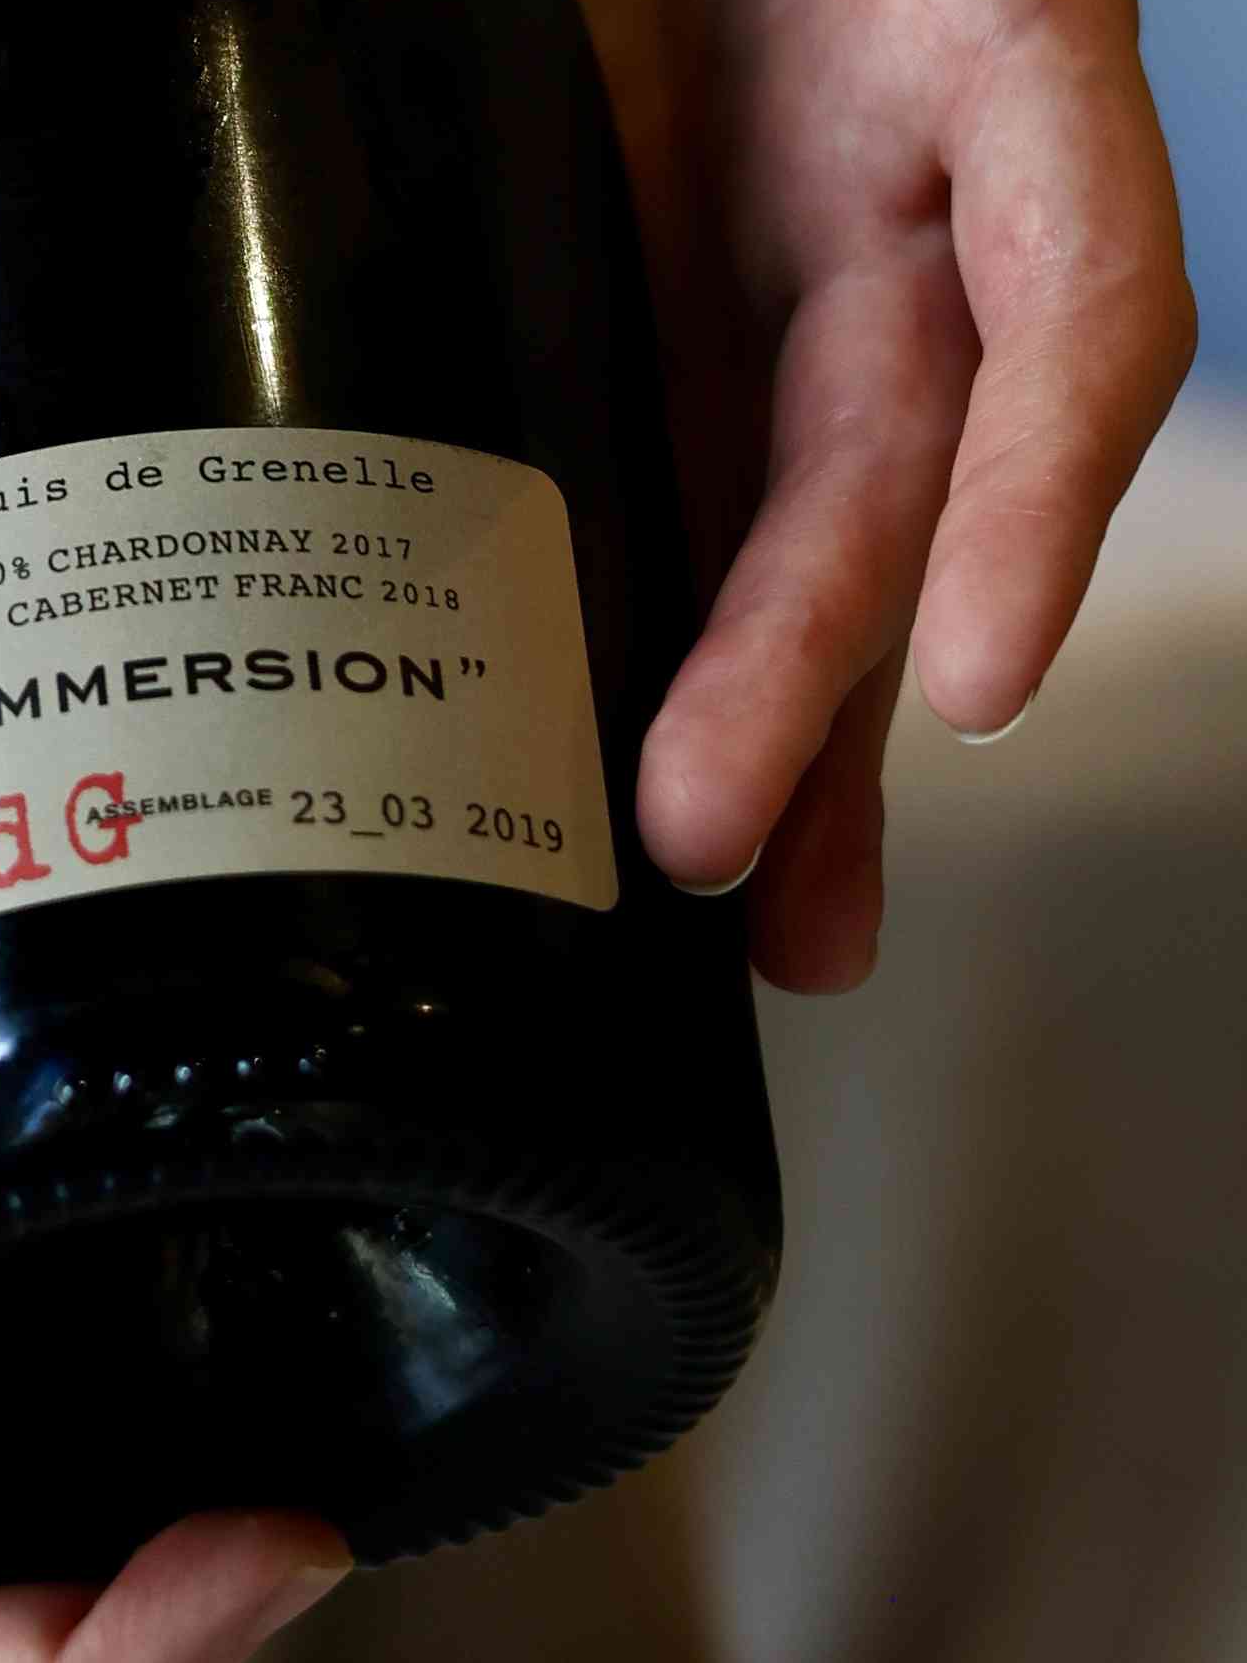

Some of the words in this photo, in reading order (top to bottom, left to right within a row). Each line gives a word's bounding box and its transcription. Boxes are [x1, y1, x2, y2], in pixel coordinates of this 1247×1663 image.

[104, 461, 164, 493] de
[199, 454, 437, 495] Grenelle
[47, 529, 313, 575] CHARDONNAY
[332, 532, 413, 561] 2017
[6, 575, 220, 630] CABERNET
[235, 573, 363, 601] FRANC
[381, 579, 460, 612] 2018
[85, 788, 273, 826] ASSEMBLAGE
[465, 802, 565, 853] 2019
